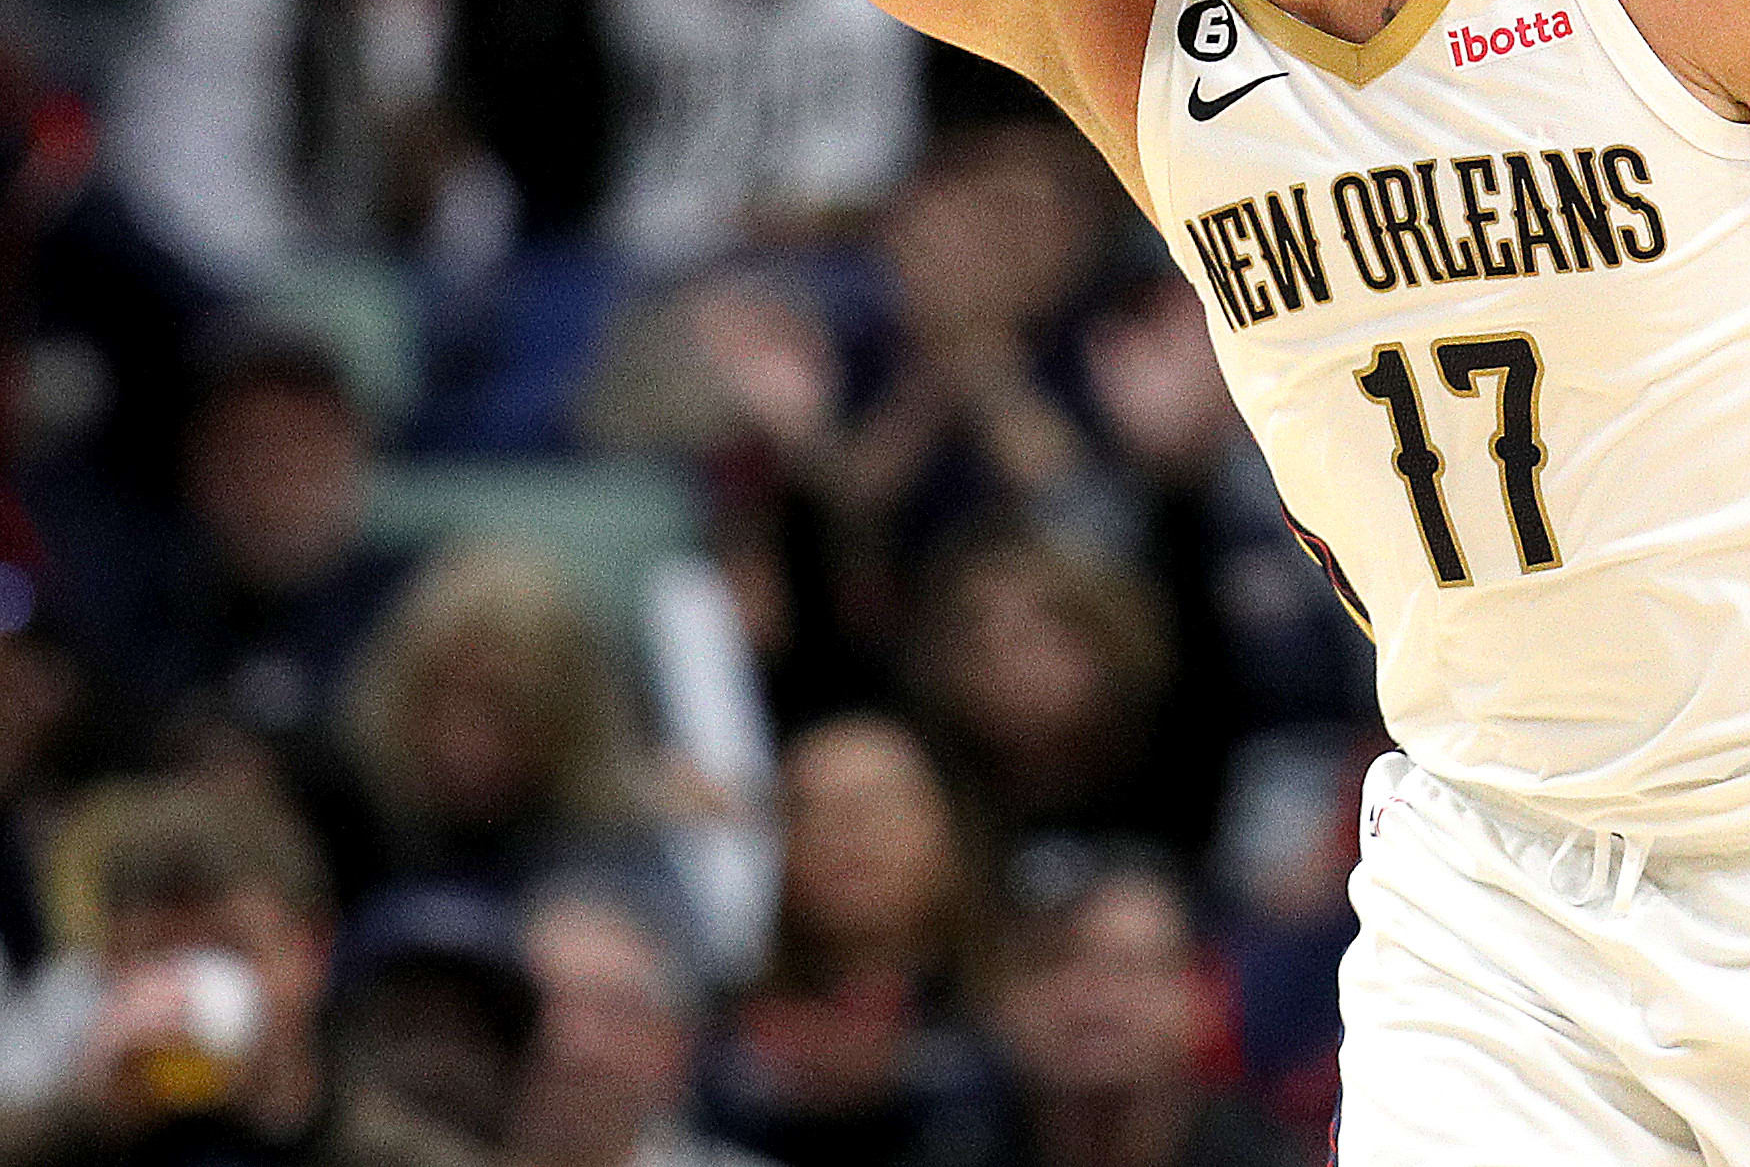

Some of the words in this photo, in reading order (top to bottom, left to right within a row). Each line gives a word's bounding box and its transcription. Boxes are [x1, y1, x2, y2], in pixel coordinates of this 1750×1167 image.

[1448, 9, 1574, 69] ibotta
[1186, 182, 1334, 332] NEW
[1329, 144, 1668, 294] ORLEANS
[1352, 330, 1564, 589] 17
